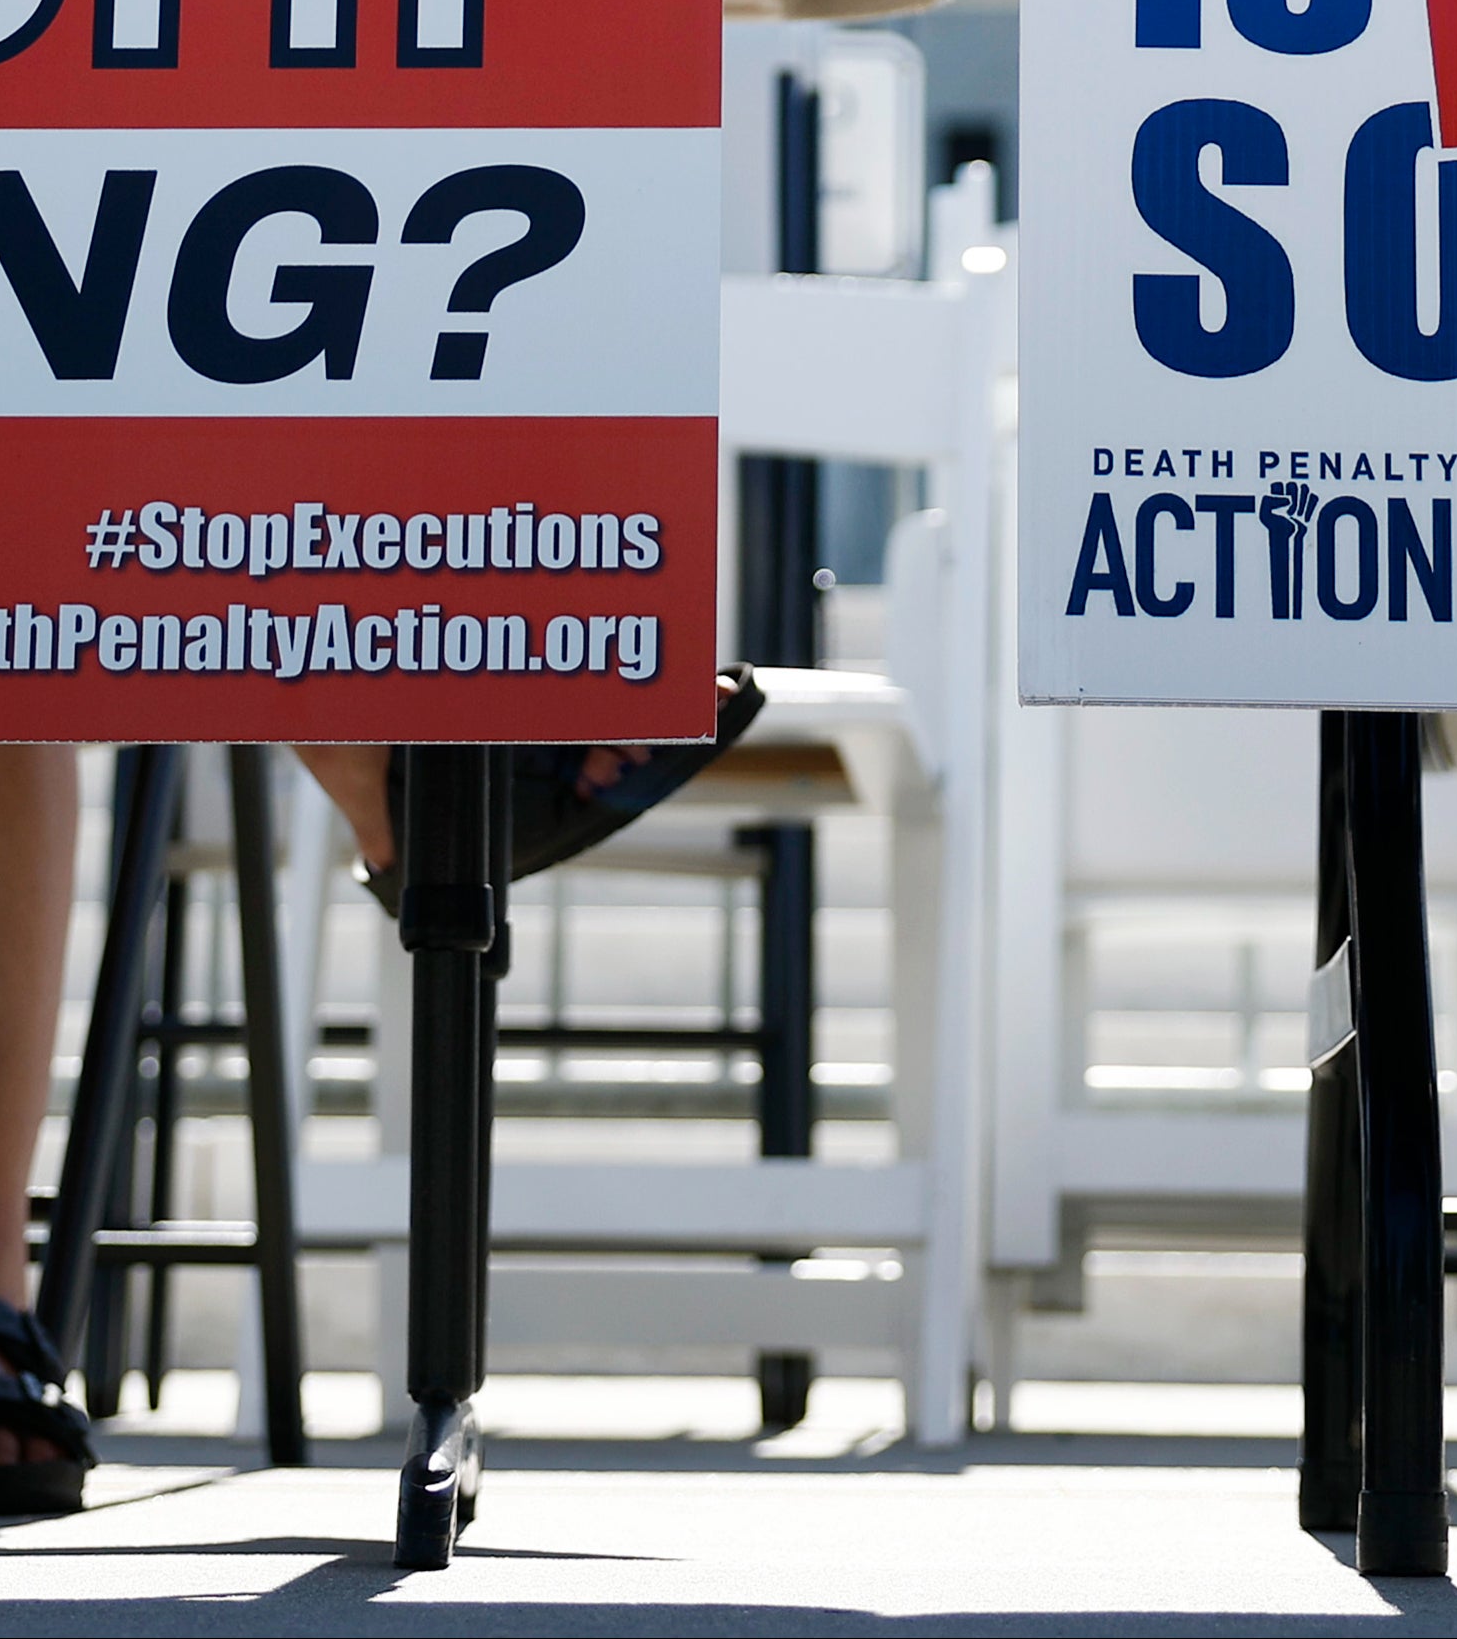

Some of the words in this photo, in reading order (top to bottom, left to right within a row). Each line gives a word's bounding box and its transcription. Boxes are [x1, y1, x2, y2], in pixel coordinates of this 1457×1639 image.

[1093, 448, 1234, 479] DEATH
[1259, 451, 1457, 482] PENALTY
[84, 500, 660, 578] #StopExecutions
